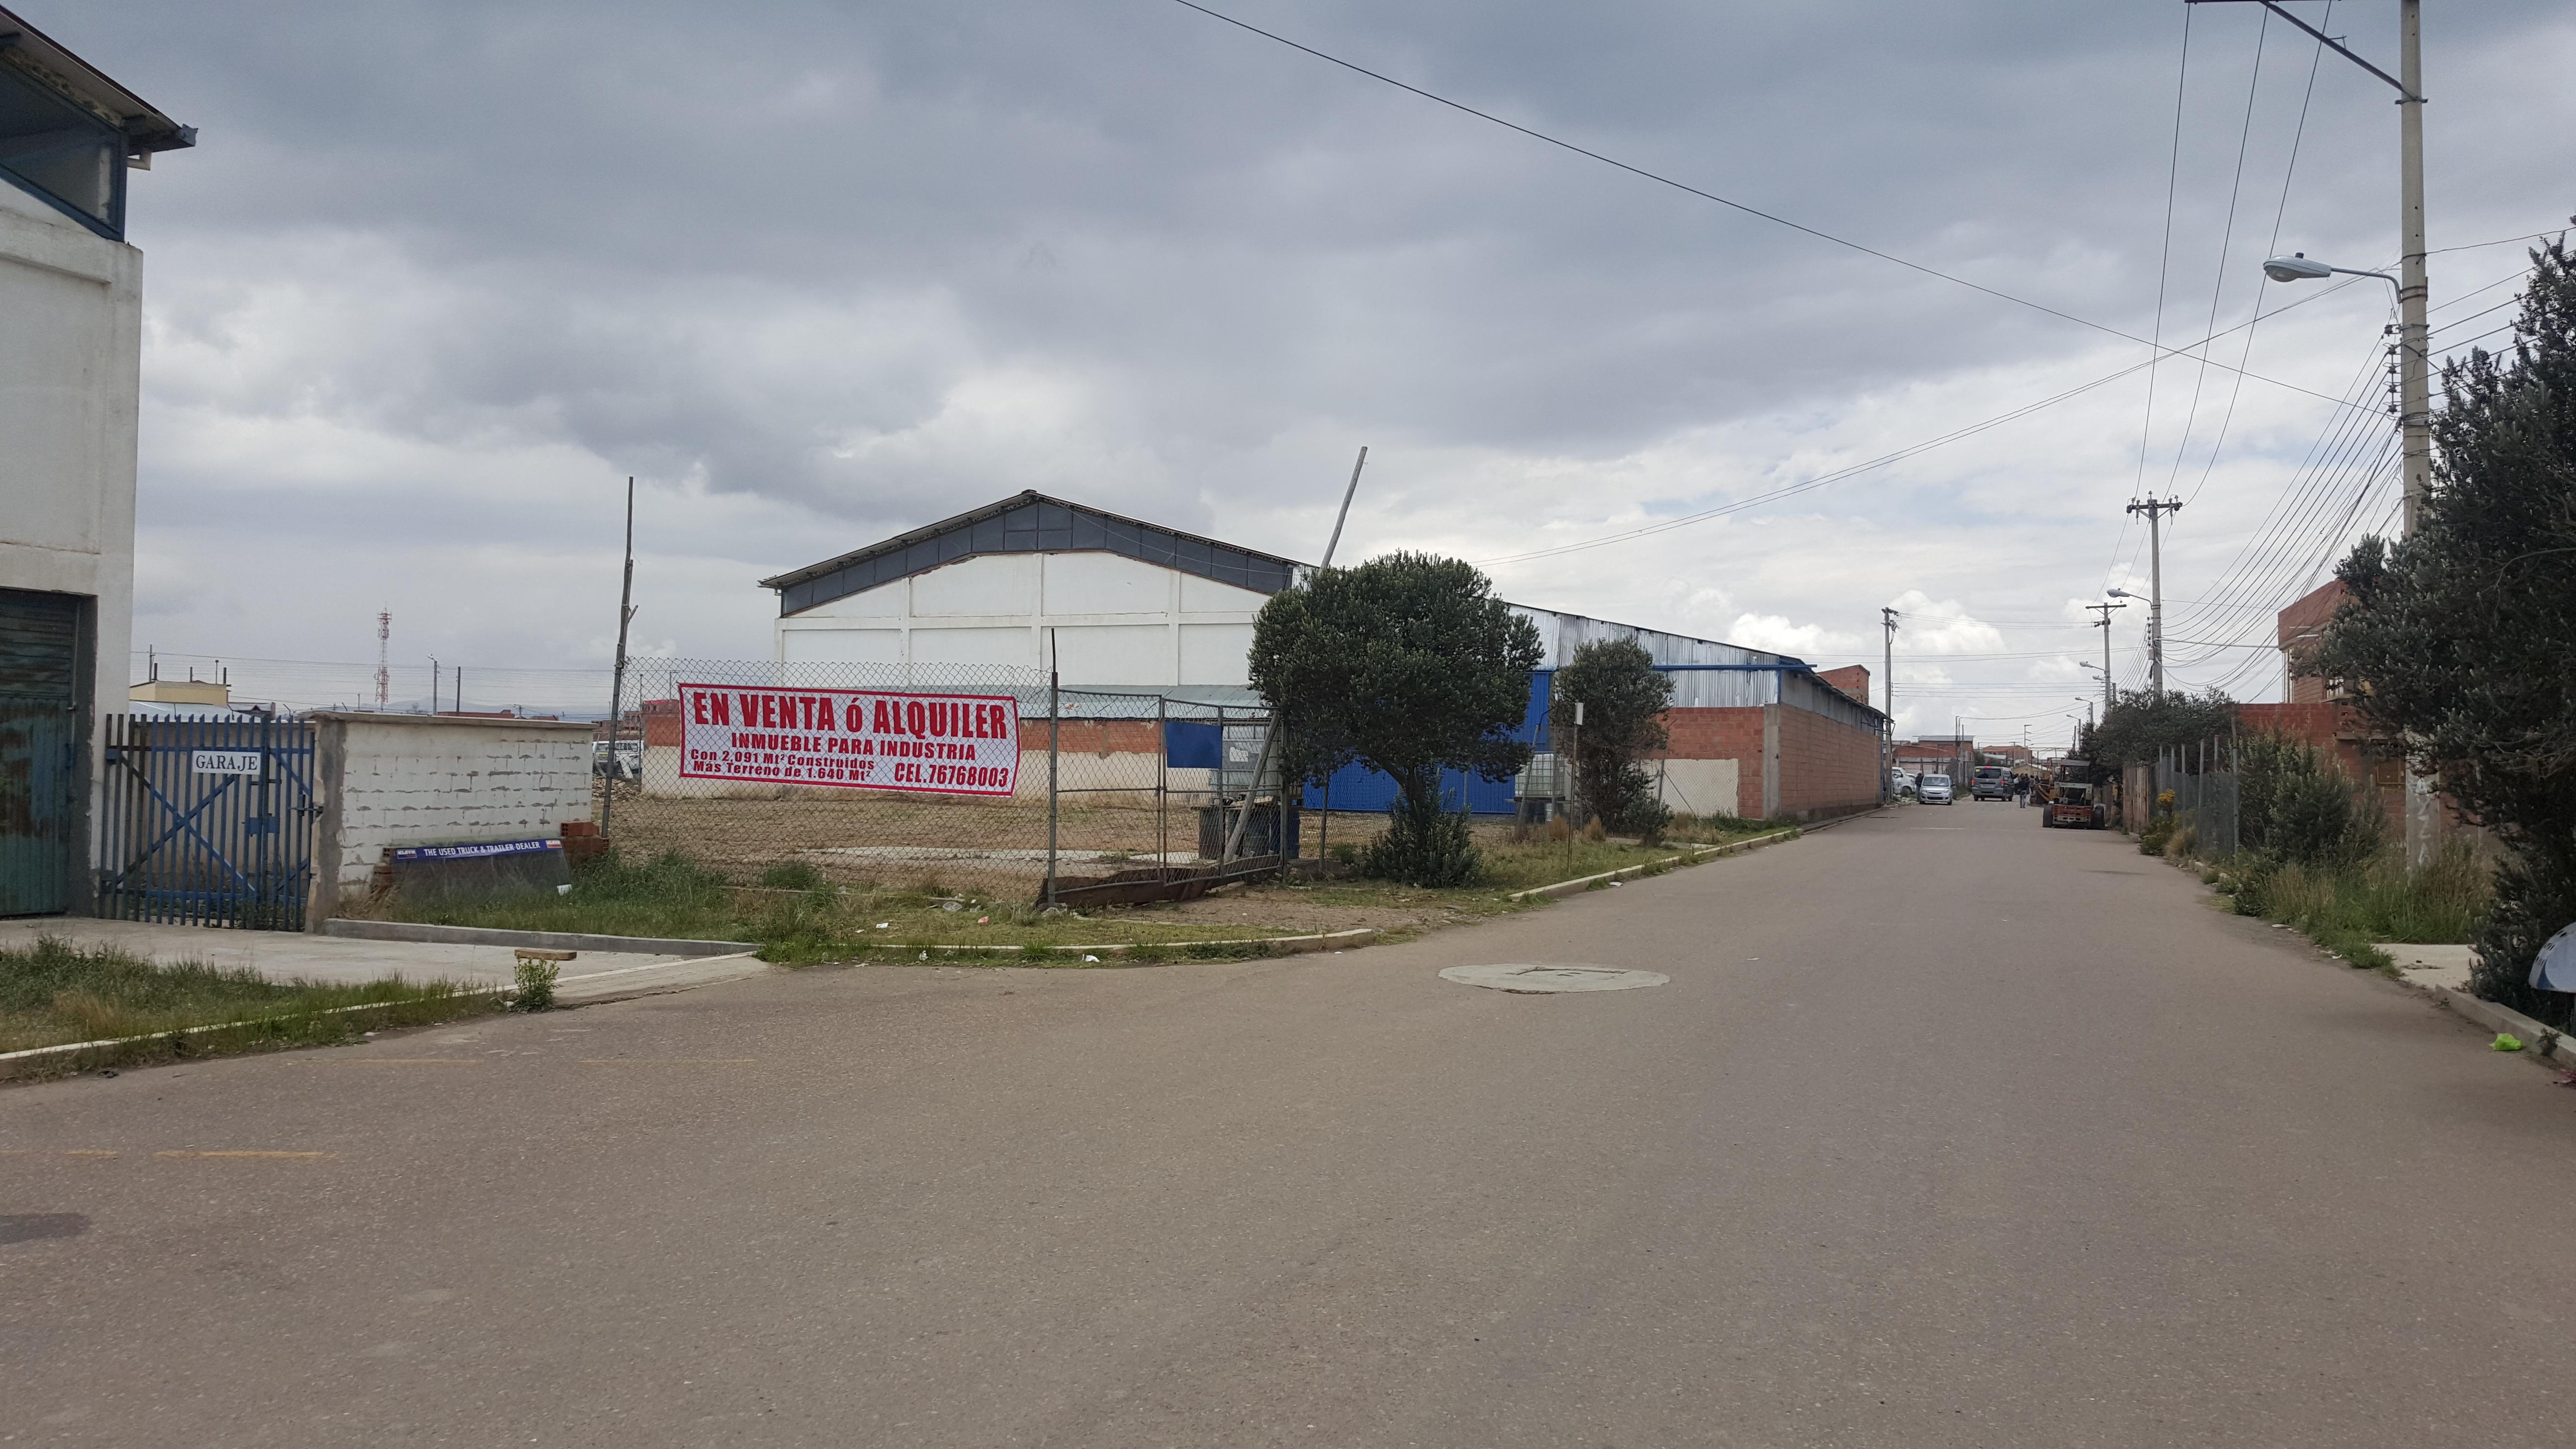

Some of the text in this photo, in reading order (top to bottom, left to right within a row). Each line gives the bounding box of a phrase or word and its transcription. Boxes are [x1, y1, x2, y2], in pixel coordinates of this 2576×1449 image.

[693, 692, 730, 726] EN
[739, 694, 836, 731] VENTA
[873, 700, 1007, 740] ALQUILER
[731, 732, 976, 761] INMUEBLE PARA INDUSTRIA
[196, 755, 258, 772] GARAJE
[691, 749, 717, 761] Con
[788, 754, 874, 770] Construidos
[693, 760, 722, 773] Más
[726, 762, 780, 776] Terreno
[784, 766, 802, 777] de
[806, 767, 844, 780] 1.640
[894, 762, 1009, 788] CEL.76768003
[439, 847, 456, 856] USED
[457, 846, 480, 855] TRUCK
[486, 843, 515, 853] TRAILER
[515, 841, 541, 851] DEALER
